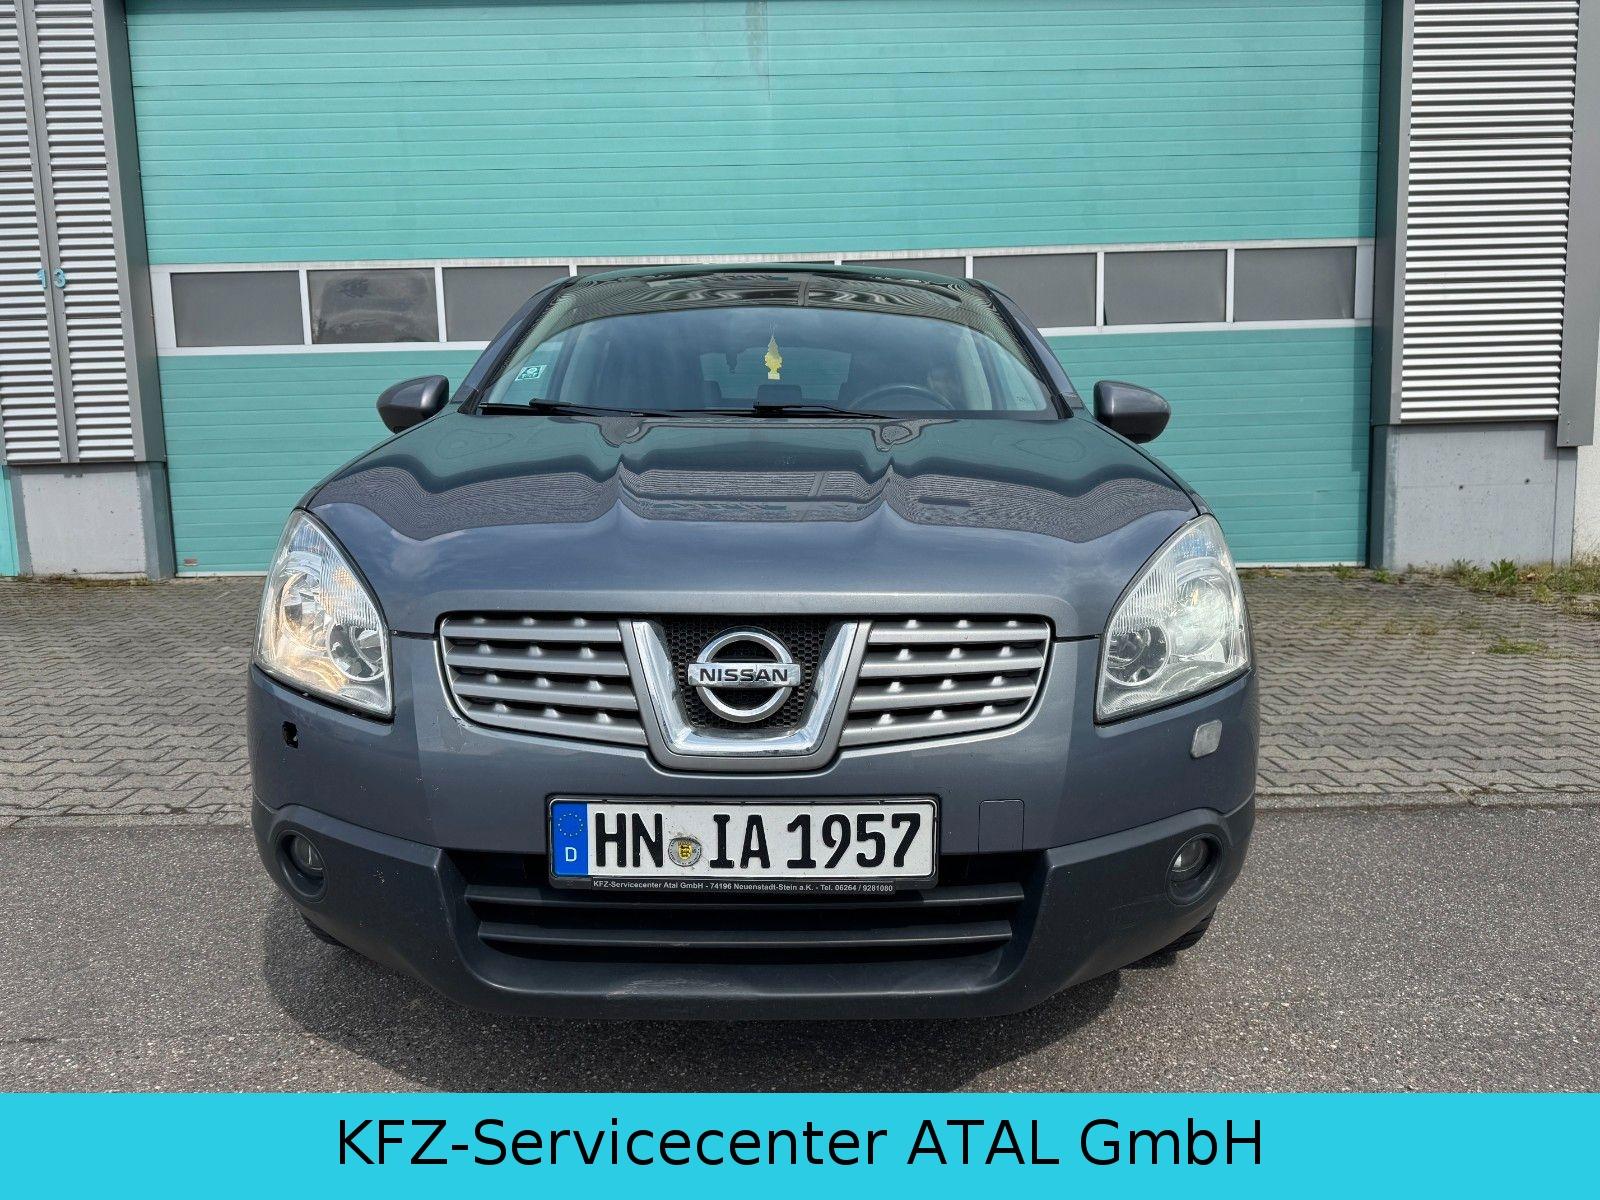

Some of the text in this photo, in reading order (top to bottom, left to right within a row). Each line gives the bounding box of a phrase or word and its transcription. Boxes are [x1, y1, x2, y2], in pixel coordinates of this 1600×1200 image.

[700, 668, 788, 682] NISSAN
[595, 812, 664, 868] HN
[709, 814, 771, 869] IA
[786, 813, 921, 869] 1957
[565, 846, 577, 863] D
[593, 880, 662, 889] KFZ-Servicecenter
[663, 881, 678, 890] Atal
[680, 882, 704, 890] GmbH
[710, 882, 732, 891] 74196
[820, 884, 833, 892] Tel.
[834, 884, 857, 892] 06264
[862, 884, 893, 893] 9281080
